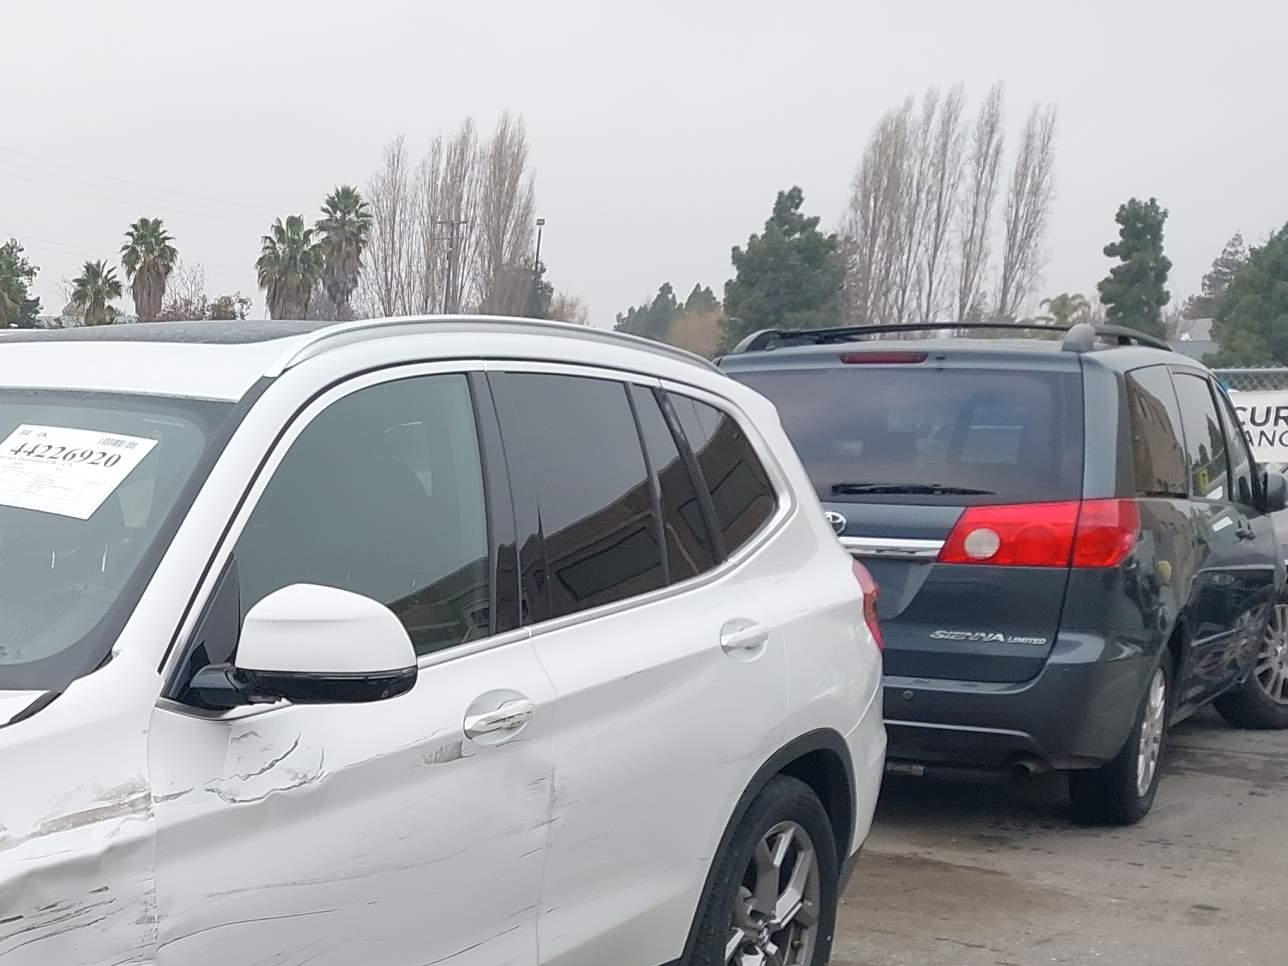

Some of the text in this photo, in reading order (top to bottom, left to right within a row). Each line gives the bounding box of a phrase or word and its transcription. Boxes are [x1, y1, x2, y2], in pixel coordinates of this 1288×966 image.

[10, 442, 122, 468] 44226920
[929, 630, 1047, 645] SIENNA LIMITED
